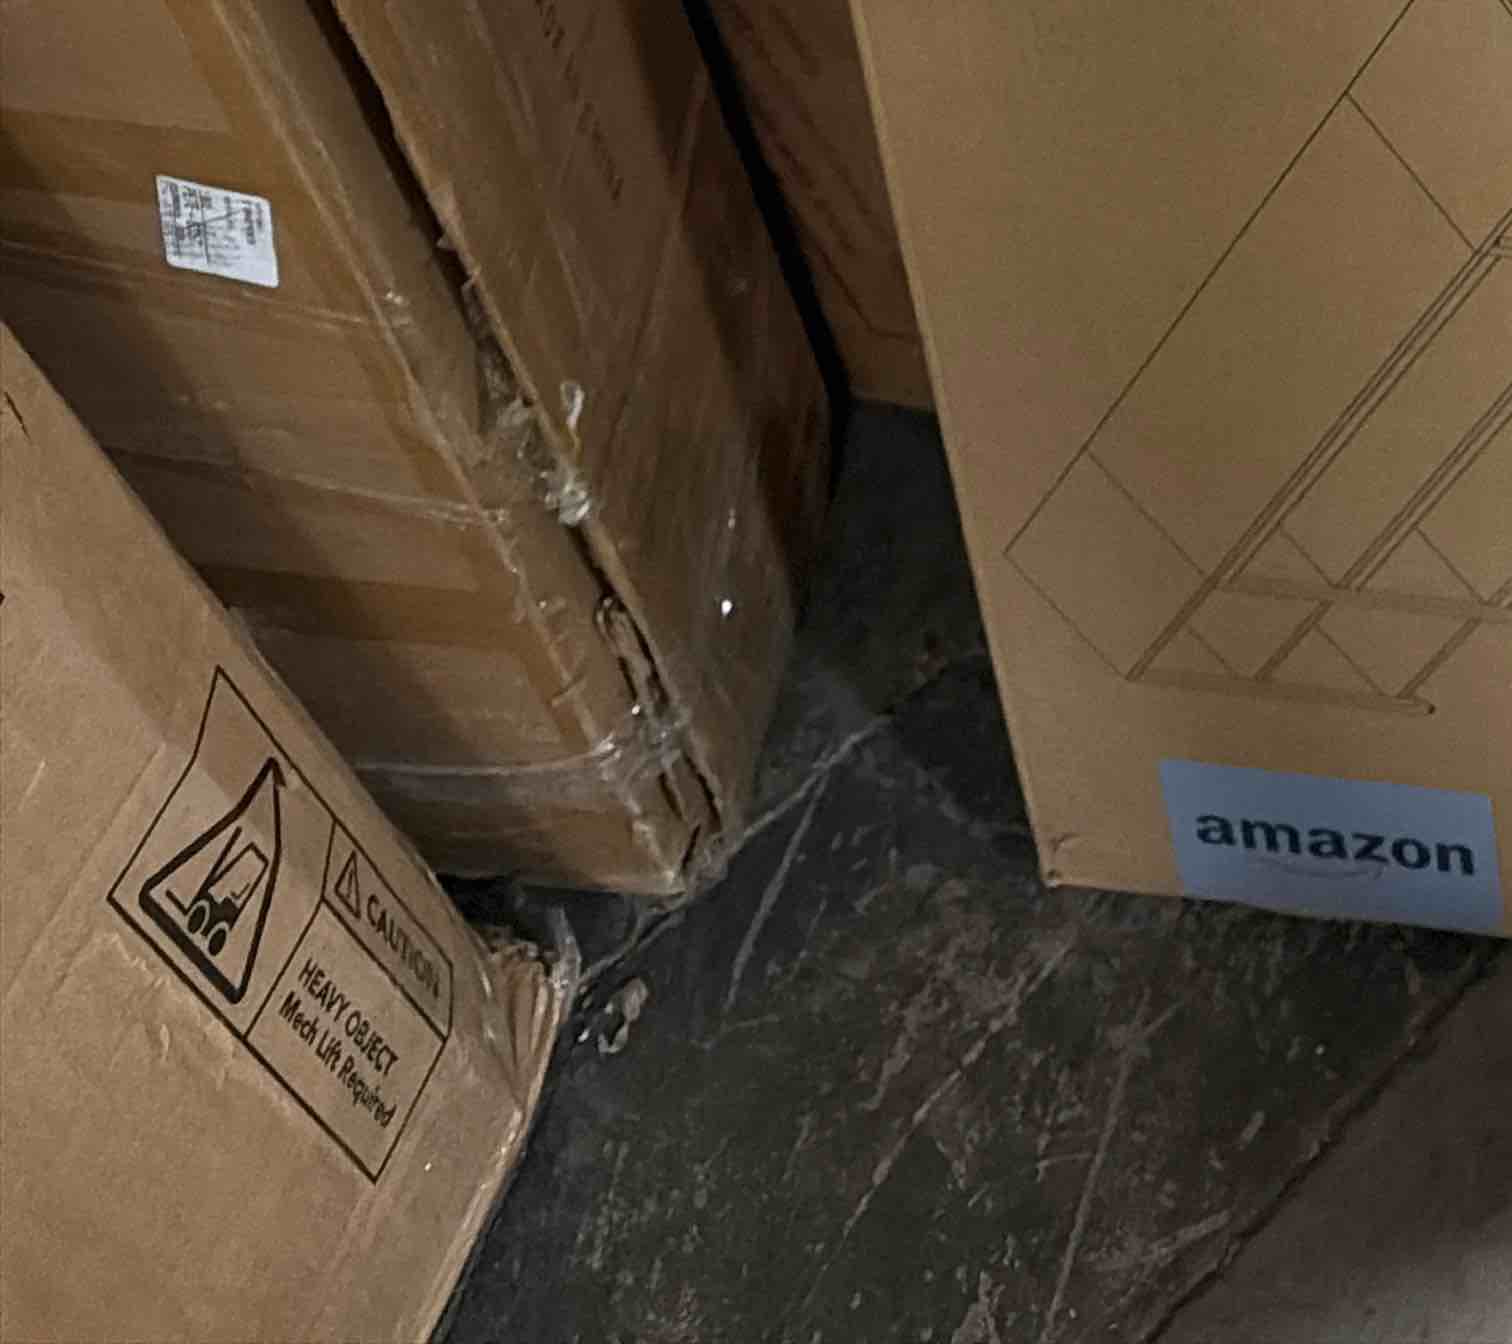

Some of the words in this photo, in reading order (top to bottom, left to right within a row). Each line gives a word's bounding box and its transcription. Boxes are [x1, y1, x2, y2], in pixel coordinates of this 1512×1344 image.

[1195, 813, 1475, 877] amazon
[366, 893, 440, 999] CAUTION
[279, 989, 320, 1046] Mech
[315, 1029, 343, 1072] Lift
[337, 1055, 398, 1129] Required
[298, 957, 350, 1023] HEAVY
[345, 1011, 400, 1077] OBJECT
